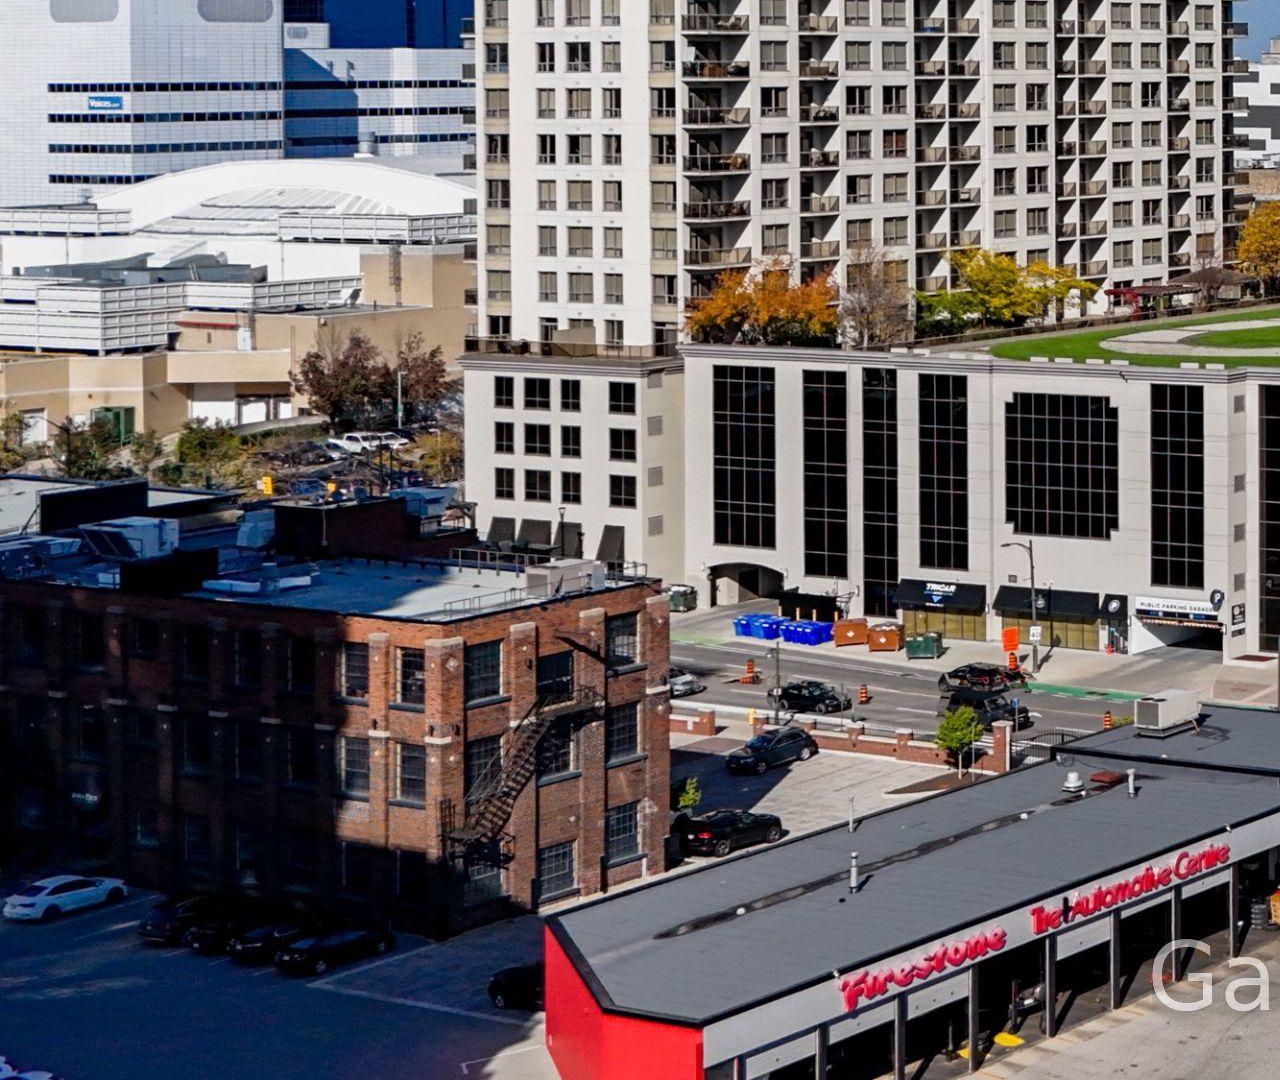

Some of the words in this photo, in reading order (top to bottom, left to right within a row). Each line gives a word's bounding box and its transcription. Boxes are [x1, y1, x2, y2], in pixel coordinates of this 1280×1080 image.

[926, 583, 957, 592] TRICAR
[1214, 593, 1221, 602] P
[1069, 864, 1173, 921] Automotive
[1174, 842, 1231, 880] Centre
[840, 925, 1007, 1013] Firestone
